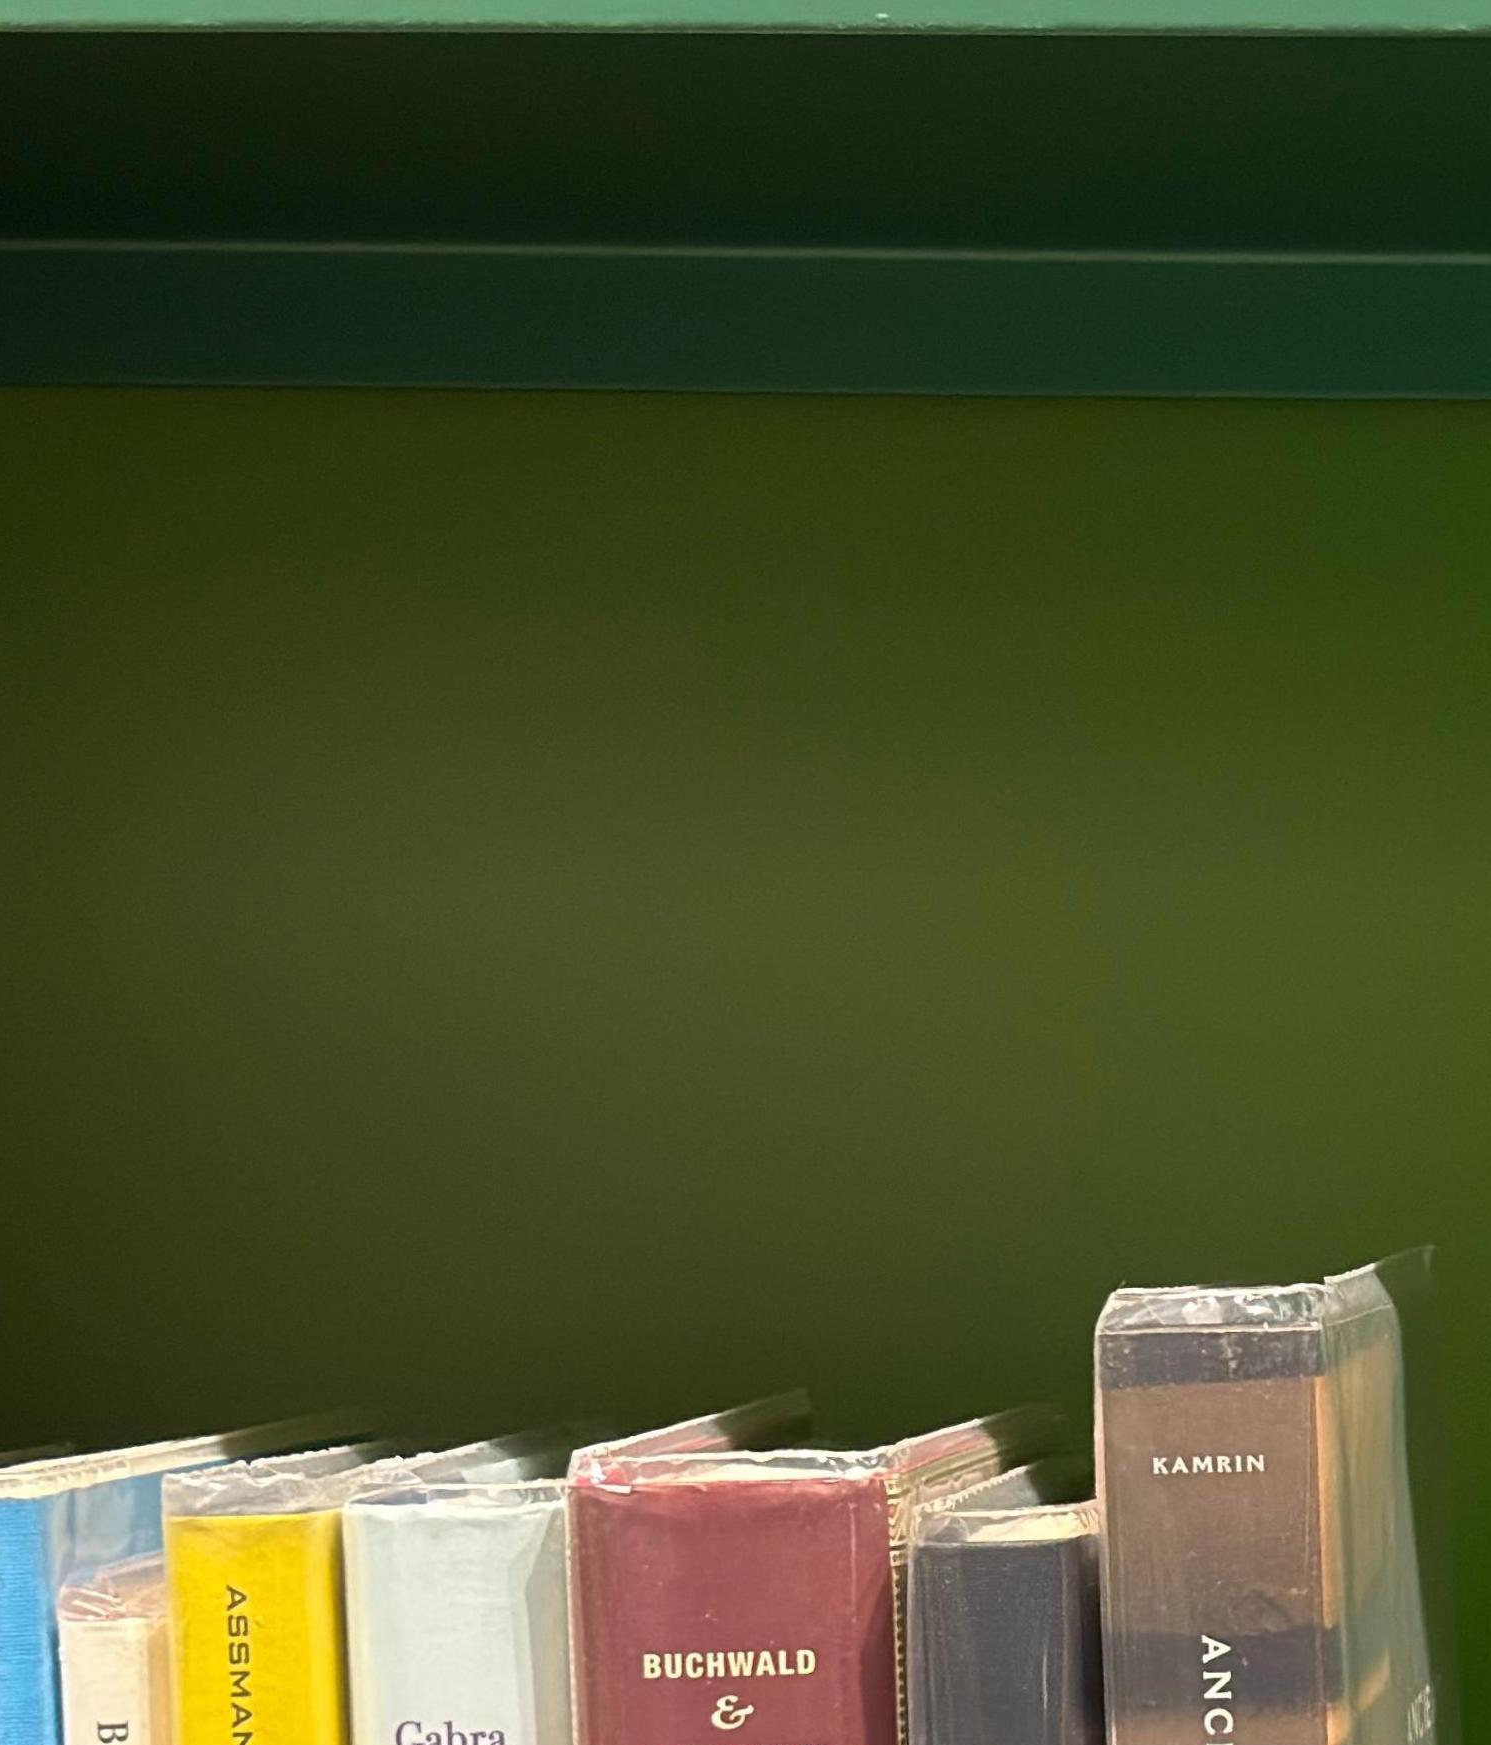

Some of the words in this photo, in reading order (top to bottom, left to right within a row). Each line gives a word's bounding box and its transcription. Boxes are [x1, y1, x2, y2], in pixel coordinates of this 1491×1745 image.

[1152, 1453, 1265, 1474] KAMRIN
[642, 1650, 817, 1680] BUCHWALD
[710, 1694, 755, 1729] &
